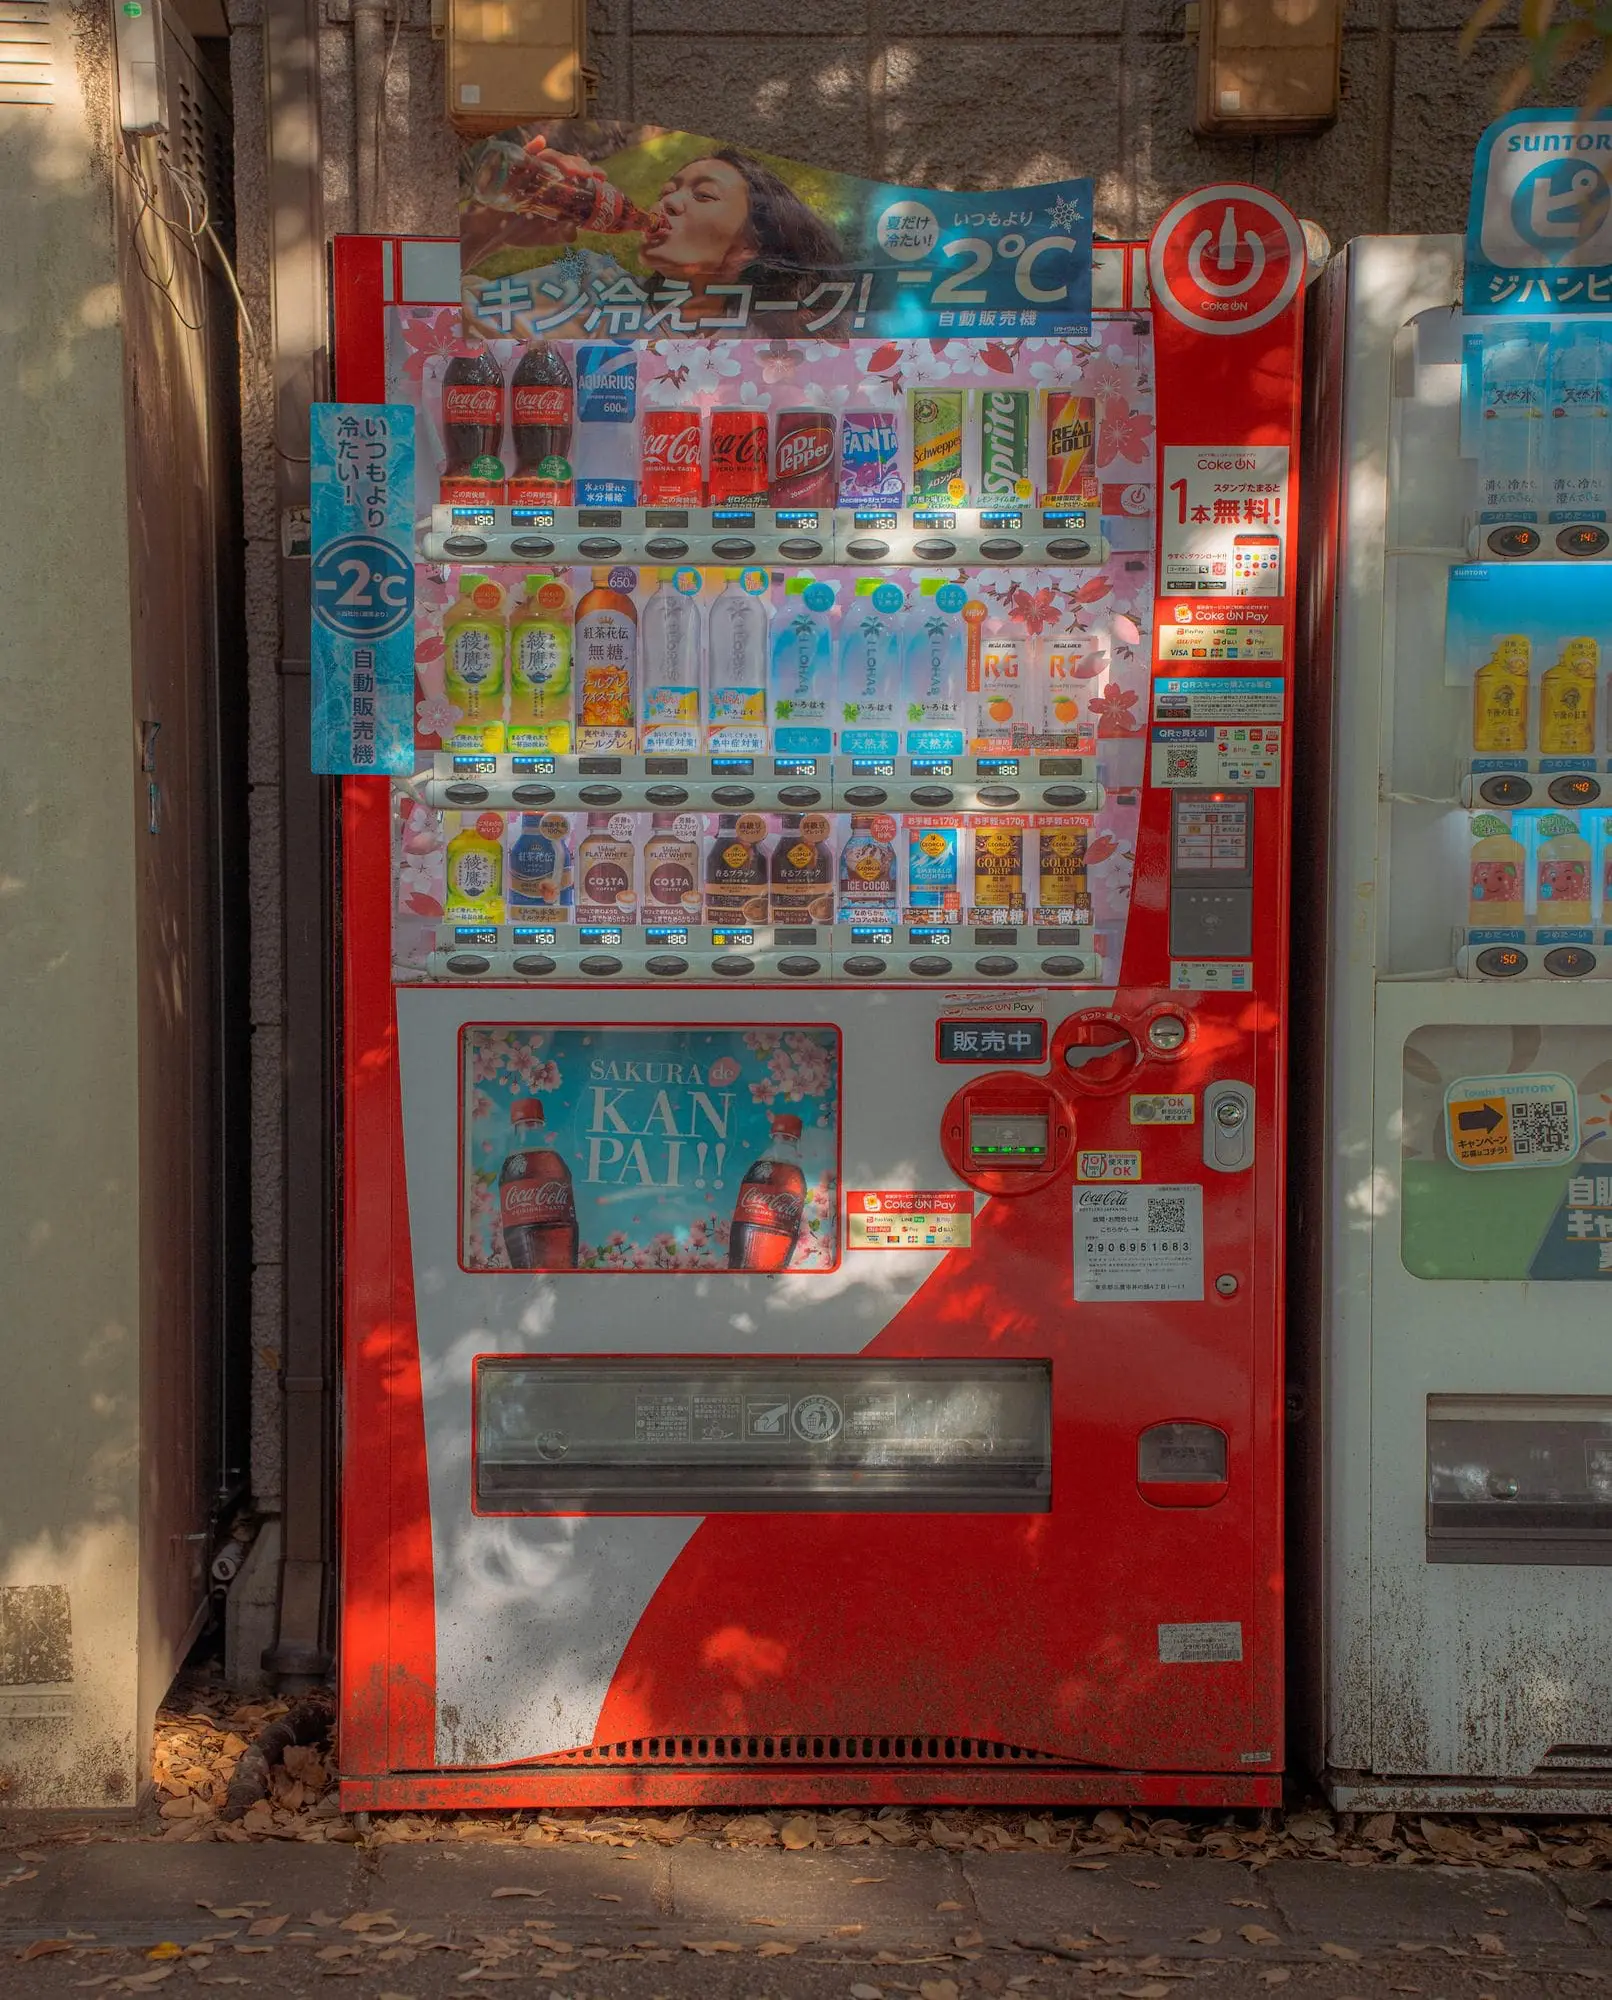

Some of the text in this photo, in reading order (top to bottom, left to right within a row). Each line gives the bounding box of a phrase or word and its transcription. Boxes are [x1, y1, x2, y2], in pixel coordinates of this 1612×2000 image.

[887, 215, 931, 231] 夏だけ
[954, 211, 1033, 227] いつもより
[884, 233, 933, 248] 冷たい!
[477, 273, 872, 334] キン冷えコーク!
[1201, 301, 1248, 311] Coke ON
[938, 310, 1037, 327] 自動販売機
[578, 375, 635, 391] AQUARIUS
[447, 389, 497, 410] Coca-Cola
[515, 390, 565, 410] Coca-Cola
[1051, 420, 1093, 443] REAL
[793, 434, 817, 449] Dr
[843, 428, 898, 454] FANTA
[913, 436, 962, 465] Schweppes
[1051, 440, 1092, 456] GOLD
[337, 415, 360, 504] 冷たい!
[780, 443, 829, 473] Pepper
[1197, 458, 1256, 470] Coke ON
[365, 417, 388, 528] いつもより
[1213, 483, 1281, 492] スタンプたまると
[586, 493, 623, 502] 水分補給
[1169, 478, 1281, 525] 1本無料!
[474, 516, 494, 526] 190
[533, 516, 553, 526] 190
[797, 518, 817, 529] 150
[875, 518, 896, 529] 150
[935, 519, 954, 529] 110
[1001, 519, 1021, 529] 110
[1065, 518, 1084, 529] 150
[1195, 610, 1269, 624] Coke ON Pay
[583, 627, 630, 639] 紅茶花伝
[461, 630, 483, 671] 綾鷹
[526, 630, 548, 671] 綾鷹
[588, 644, 625, 661] 無糖
[984, 654, 1019, 678] RG
[351, 650, 375, 764] 自動販売機
[1487, 707, 1520, 717] 午後の紅茶
[1553, 710, 1588, 720] 午後の紅茶
[1159, 729, 1208, 738] QRで買える!
[578, 738, 633, 750] アールグレイ
[646, 737, 697, 748] 熱中症対策!
[711, 737, 763, 748] 熱中症対策!
[851, 739, 889, 749] 天然水
[917, 739, 955, 749] 天然水
[475, 763, 495, 774] 150
[534, 763, 553, 774] 150
[796, 765, 815, 776] 140
[874, 765, 893, 776] 140
[932, 765, 951, 776] 140
[998, 765, 1018, 776] 180
[976, 857, 1020, 868] GOLDEN
[1041, 857, 1086, 868] GOLDEN
[463, 854, 482, 887] 綾鷹
[588, 877, 625, 886] COSTA
[653, 877, 690, 886] COSTA
[847, 880, 890, 890] ICE COCOA
[927, 909, 959, 924] 王道
[992, 909, 1025, 925] 微糖
[1057, 909, 1089, 925] 微糖
[476, 934, 496, 944] 140
[535, 934, 555, 944] 150
[732, 934, 753, 945] 140
[931, 934, 950, 944] 120
[1013, 1002, 1035, 1013] Pay
[952, 1030, 1032, 1052] 販売中
[590, 1058, 734, 1085] SAKURA de
[1499, 1084, 1557, 1095] SUNTORY
[1168, 1098, 1185, 1107] OK
[585, 1086, 737, 1140] KAN
[1457, 1135, 1508, 1149] キャンペーン
[1461, 1147, 1508, 1159] 応募はコチラ!
[581, 1136, 726, 1190] PAI!!
[1112, 1167, 1131, 1176] OK
[505, 1181, 569, 1208] Coca-Cola
[1079, 1190, 1131, 1206] Coca-Cola
[742, 1187, 801, 1217] Coca-Cola
[884, 1198, 956, 1211] Coke ON Pay
